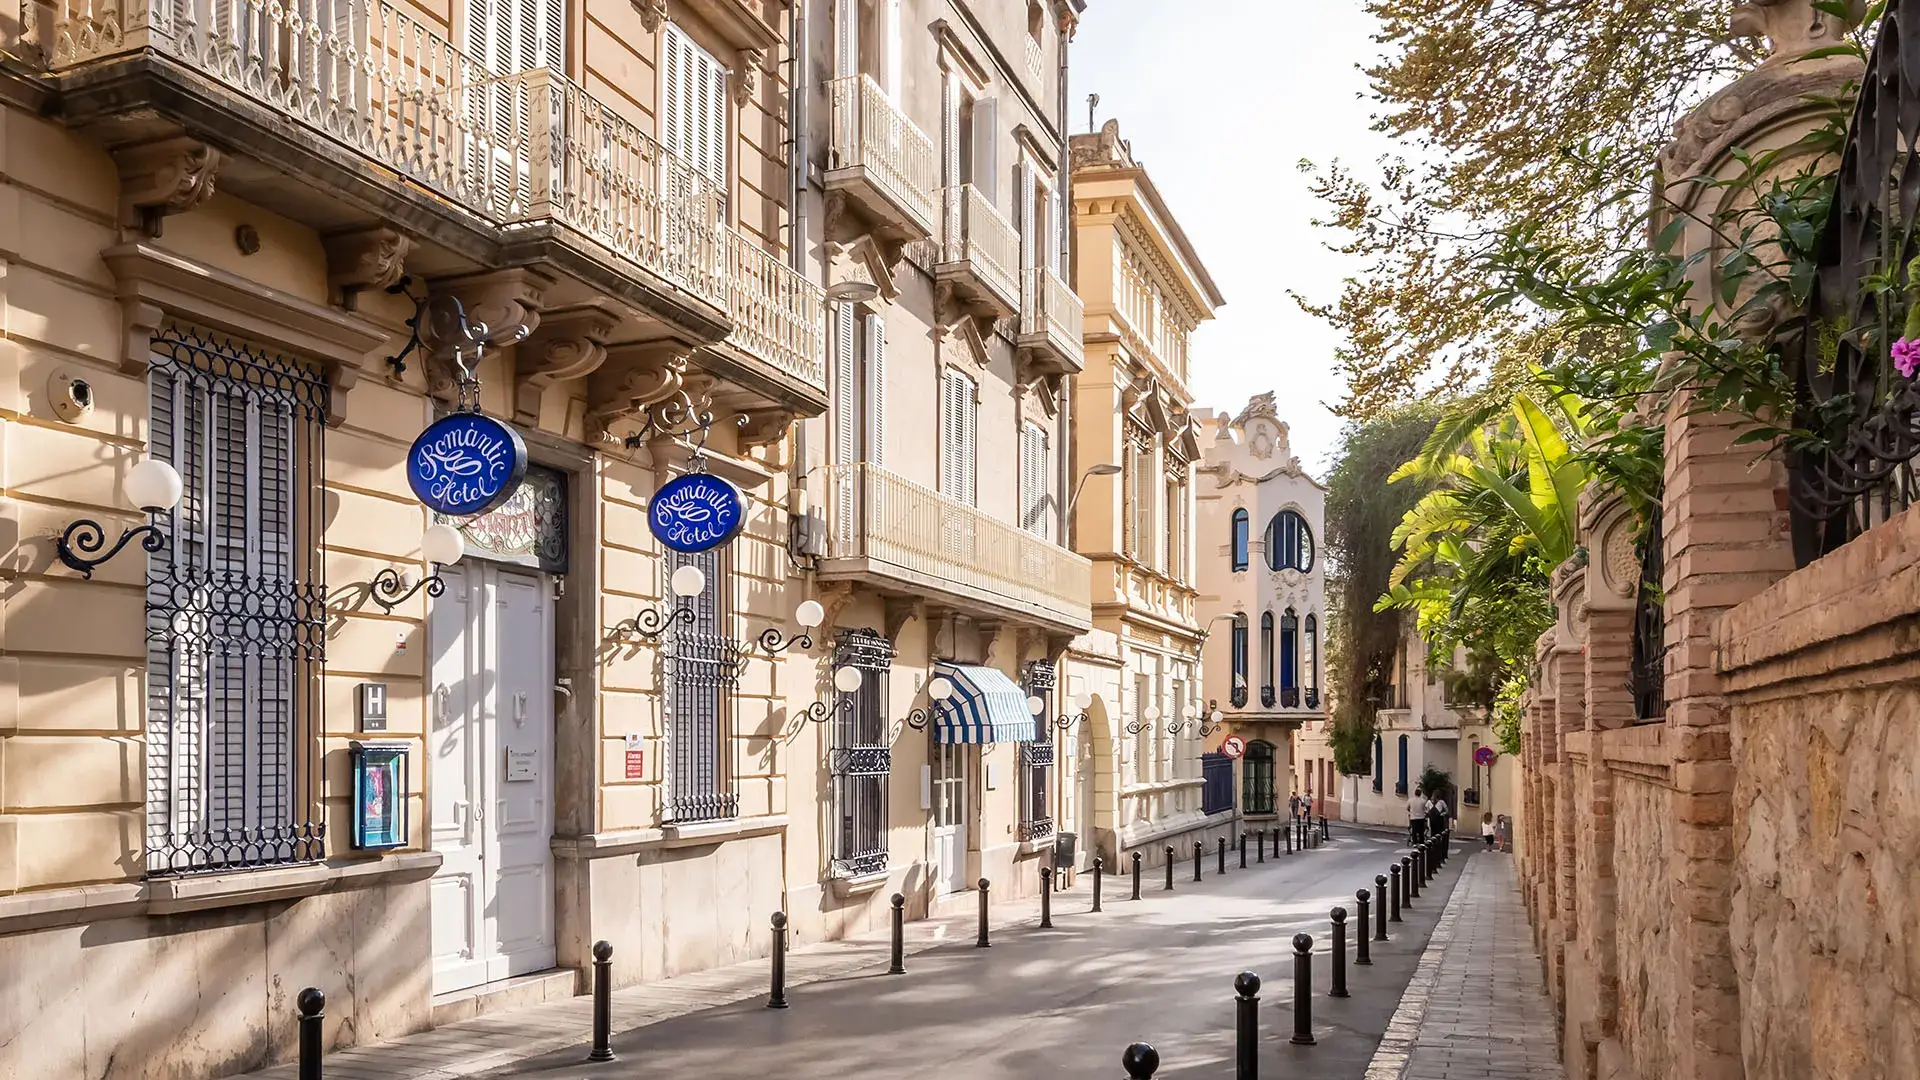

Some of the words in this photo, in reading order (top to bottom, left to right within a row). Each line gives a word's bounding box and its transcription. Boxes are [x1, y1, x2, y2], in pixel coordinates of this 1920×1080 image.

[418, 422, 507, 480] Romántic
[431, 475, 498, 505] Hotel
[656, 480, 731, 526] Romántic
[668, 521, 724, 545] Hotel
[368, 687, 382, 715] H
